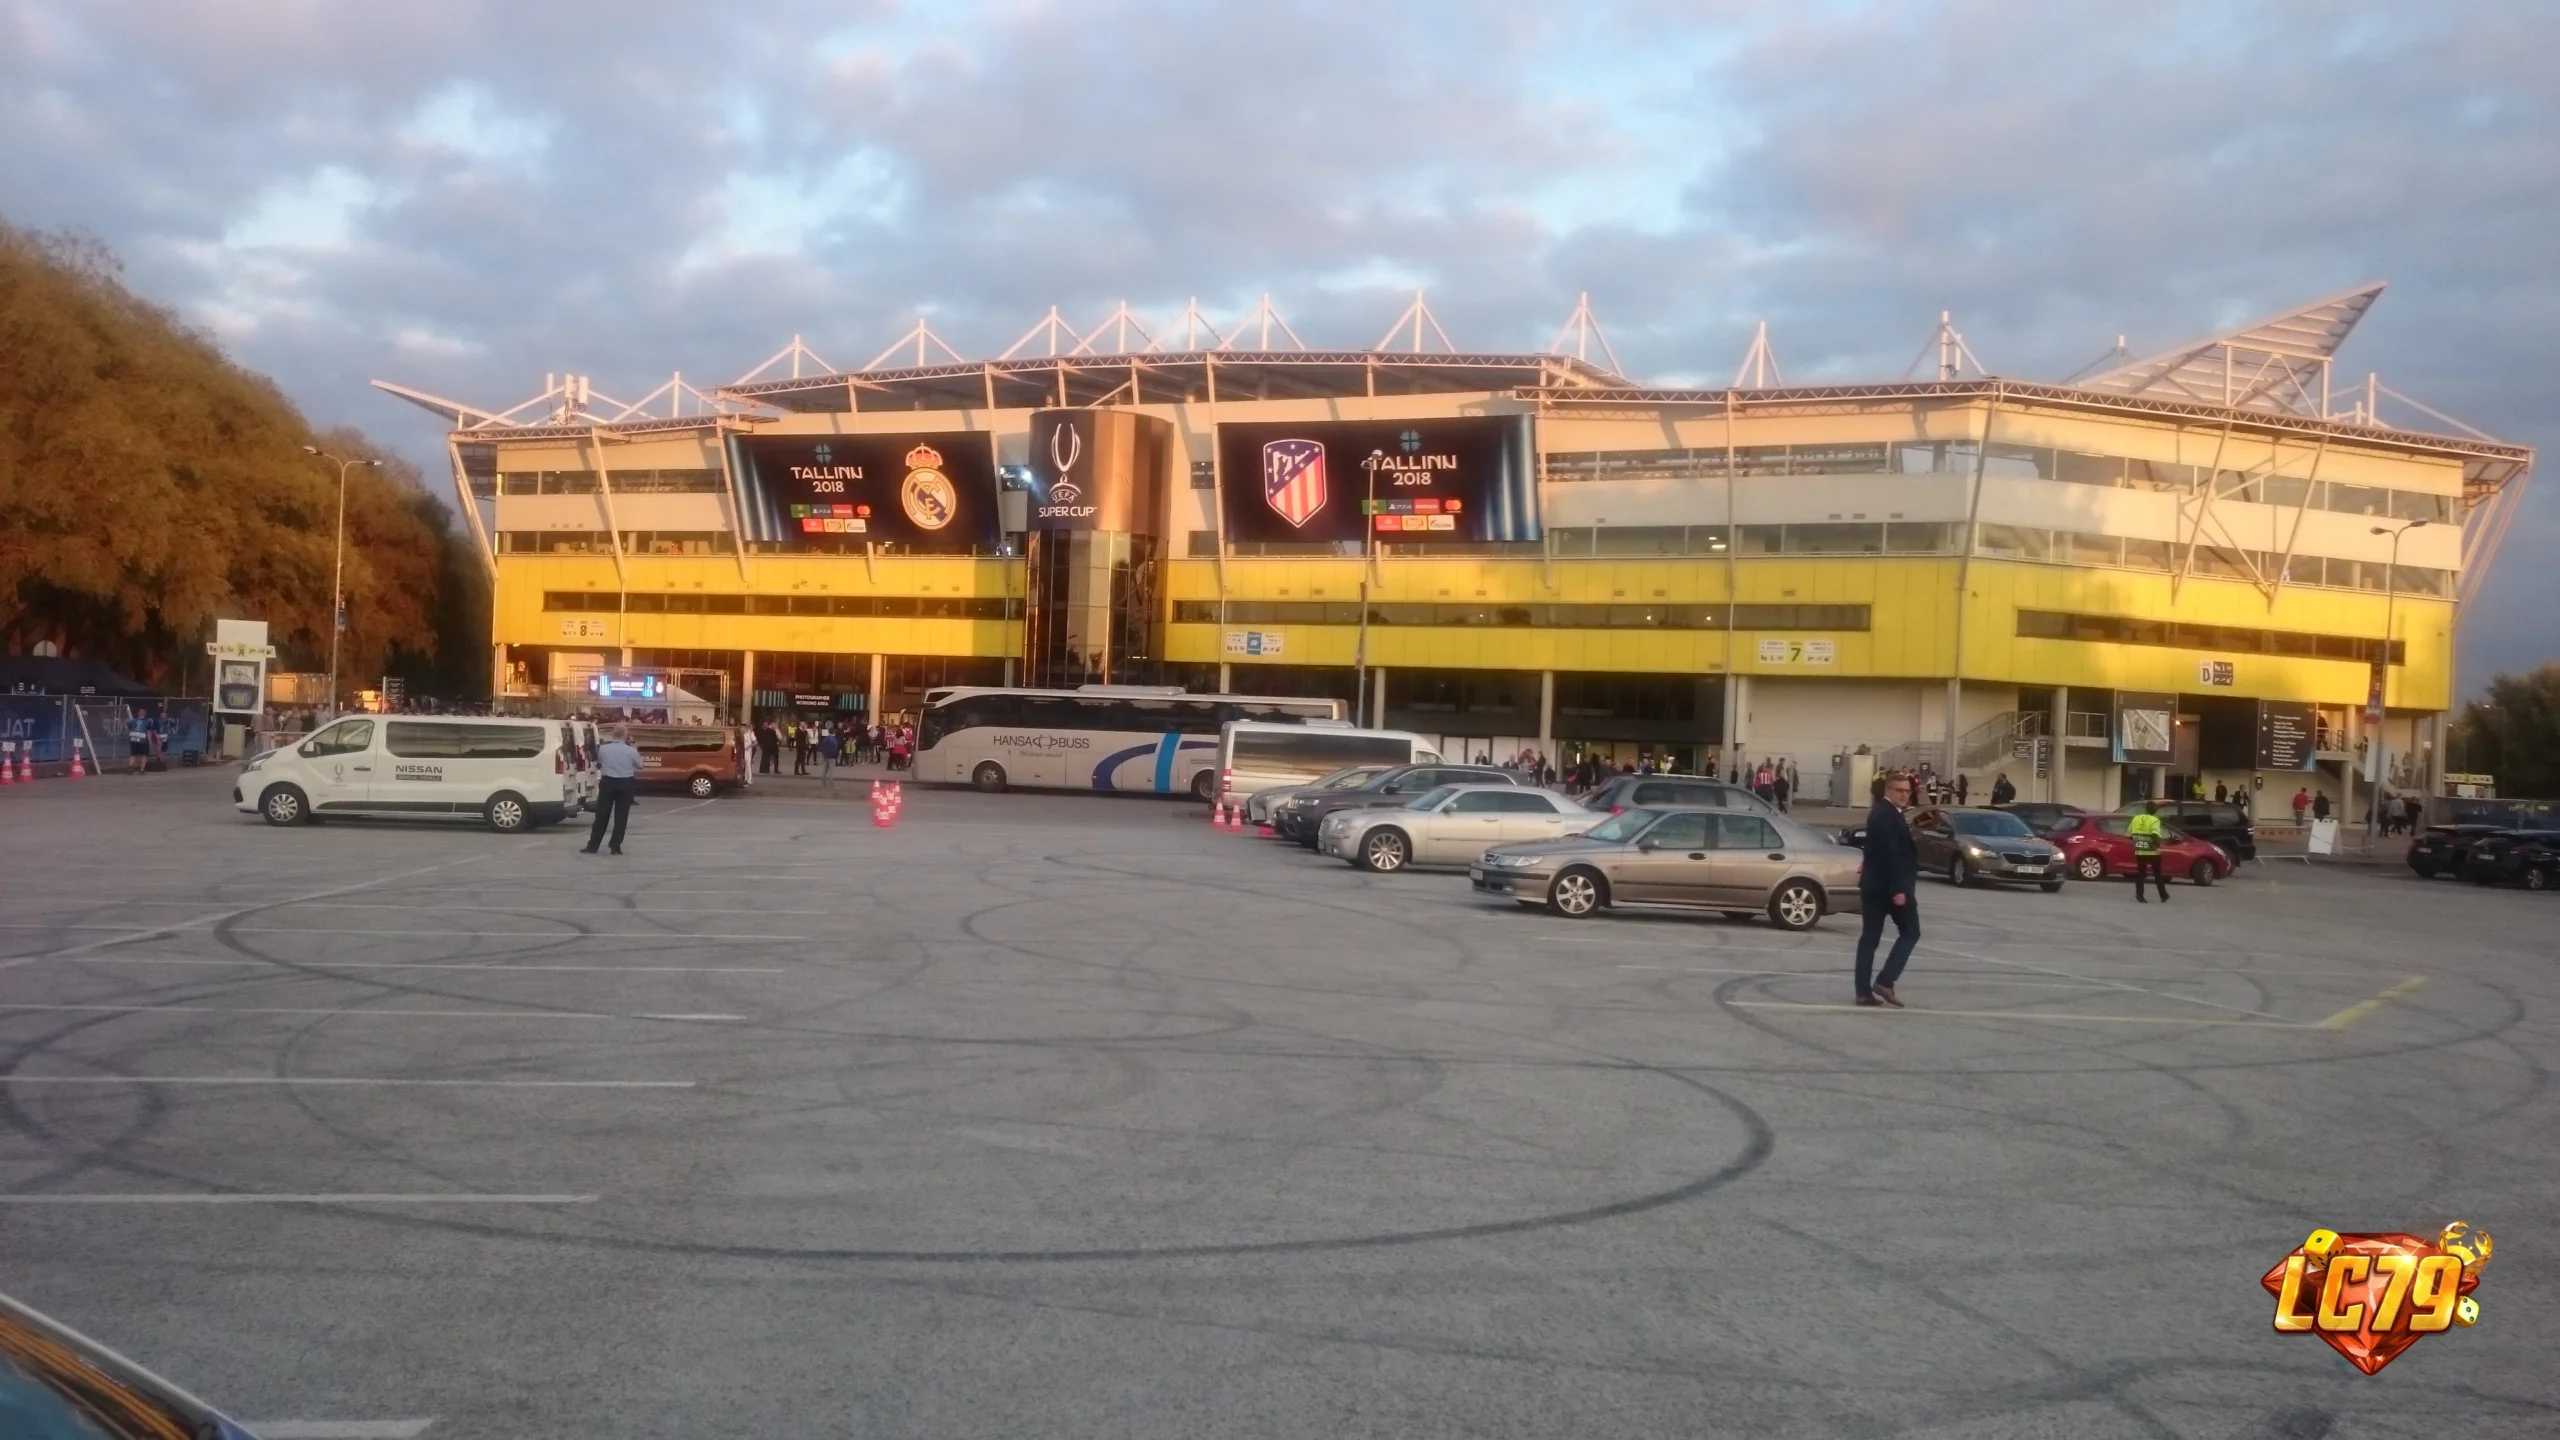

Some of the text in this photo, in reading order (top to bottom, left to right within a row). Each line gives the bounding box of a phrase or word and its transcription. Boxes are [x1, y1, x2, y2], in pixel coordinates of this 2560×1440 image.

[1369, 455, 1457, 470] TALLINN
[790, 466, 863, 480] TALLINN
[1392, 472, 1432, 485] 2018
[813, 480, 845, 493] 2018
[1051, 491, 1075, 502] UEFA
[1038, 506, 1095, 517] SUPER CUP
[580, 625, 587, 636] 8
[1791, 647, 1801, 661] 7
[2202, 667, 2211, 682] D
[993, 735, 1090, 749] HANSA BUSS
[395, 764, 443, 774] NISSAN
